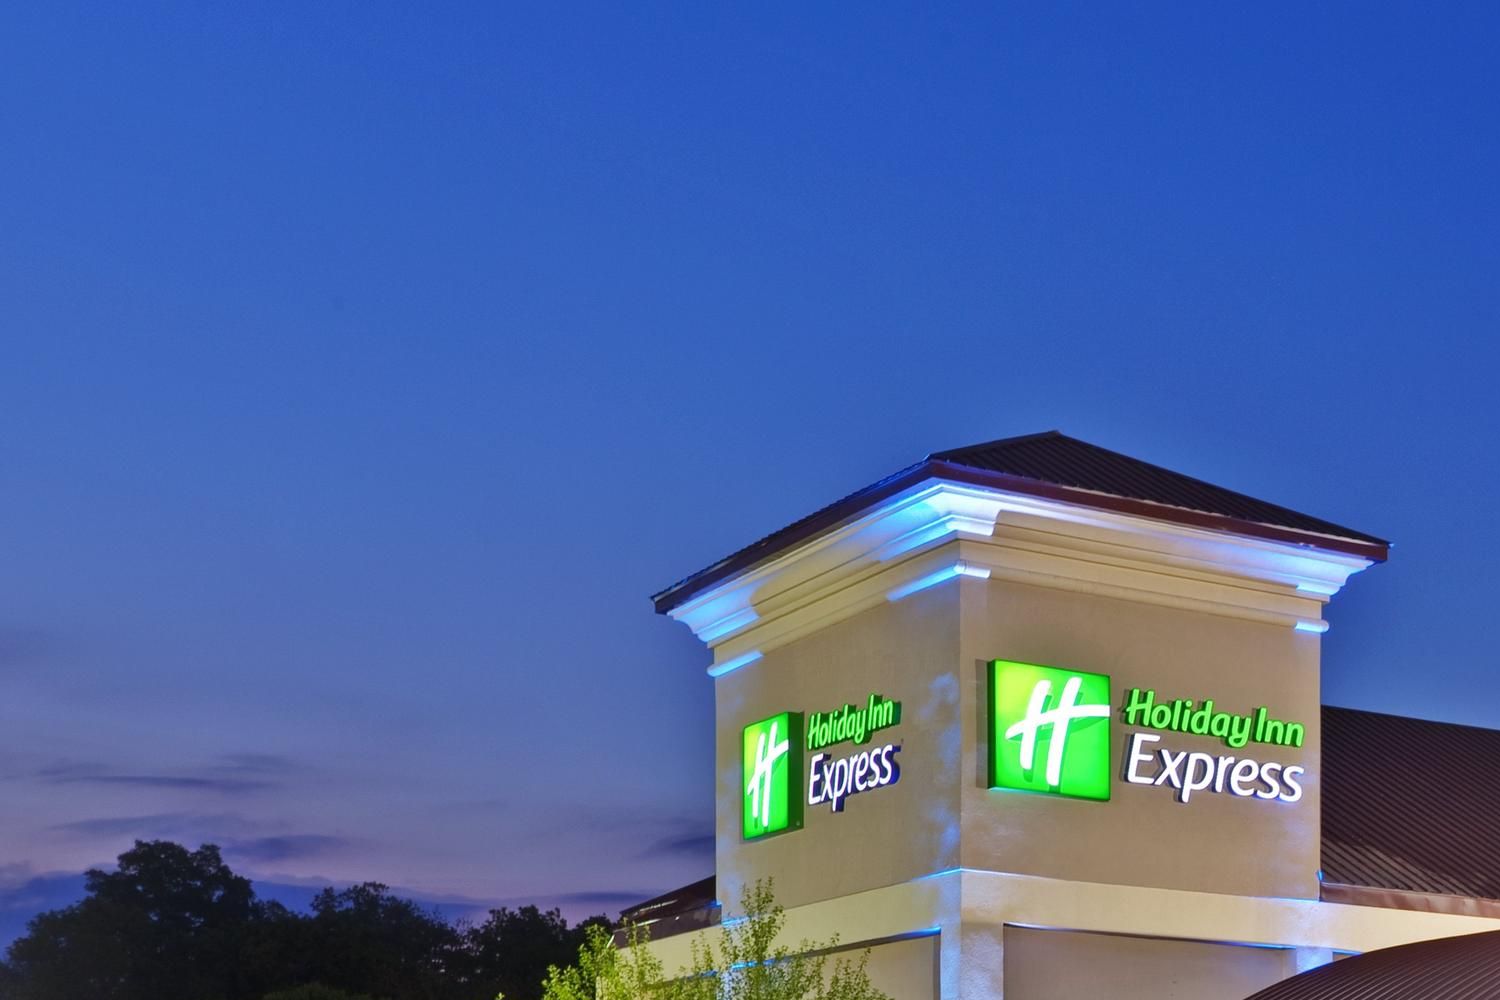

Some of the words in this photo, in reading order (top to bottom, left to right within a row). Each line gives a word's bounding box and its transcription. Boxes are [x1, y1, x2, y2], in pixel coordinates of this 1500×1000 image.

[807, 703, 867, 751] Holiday
[867, 693, 894, 732] Inn
[1126, 688, 1252, 748] Holiday
[1255, 707, 1305, 747] Inn
[808, 744, 894, 812] Express
[1127, 732, 1305, 803] Express
